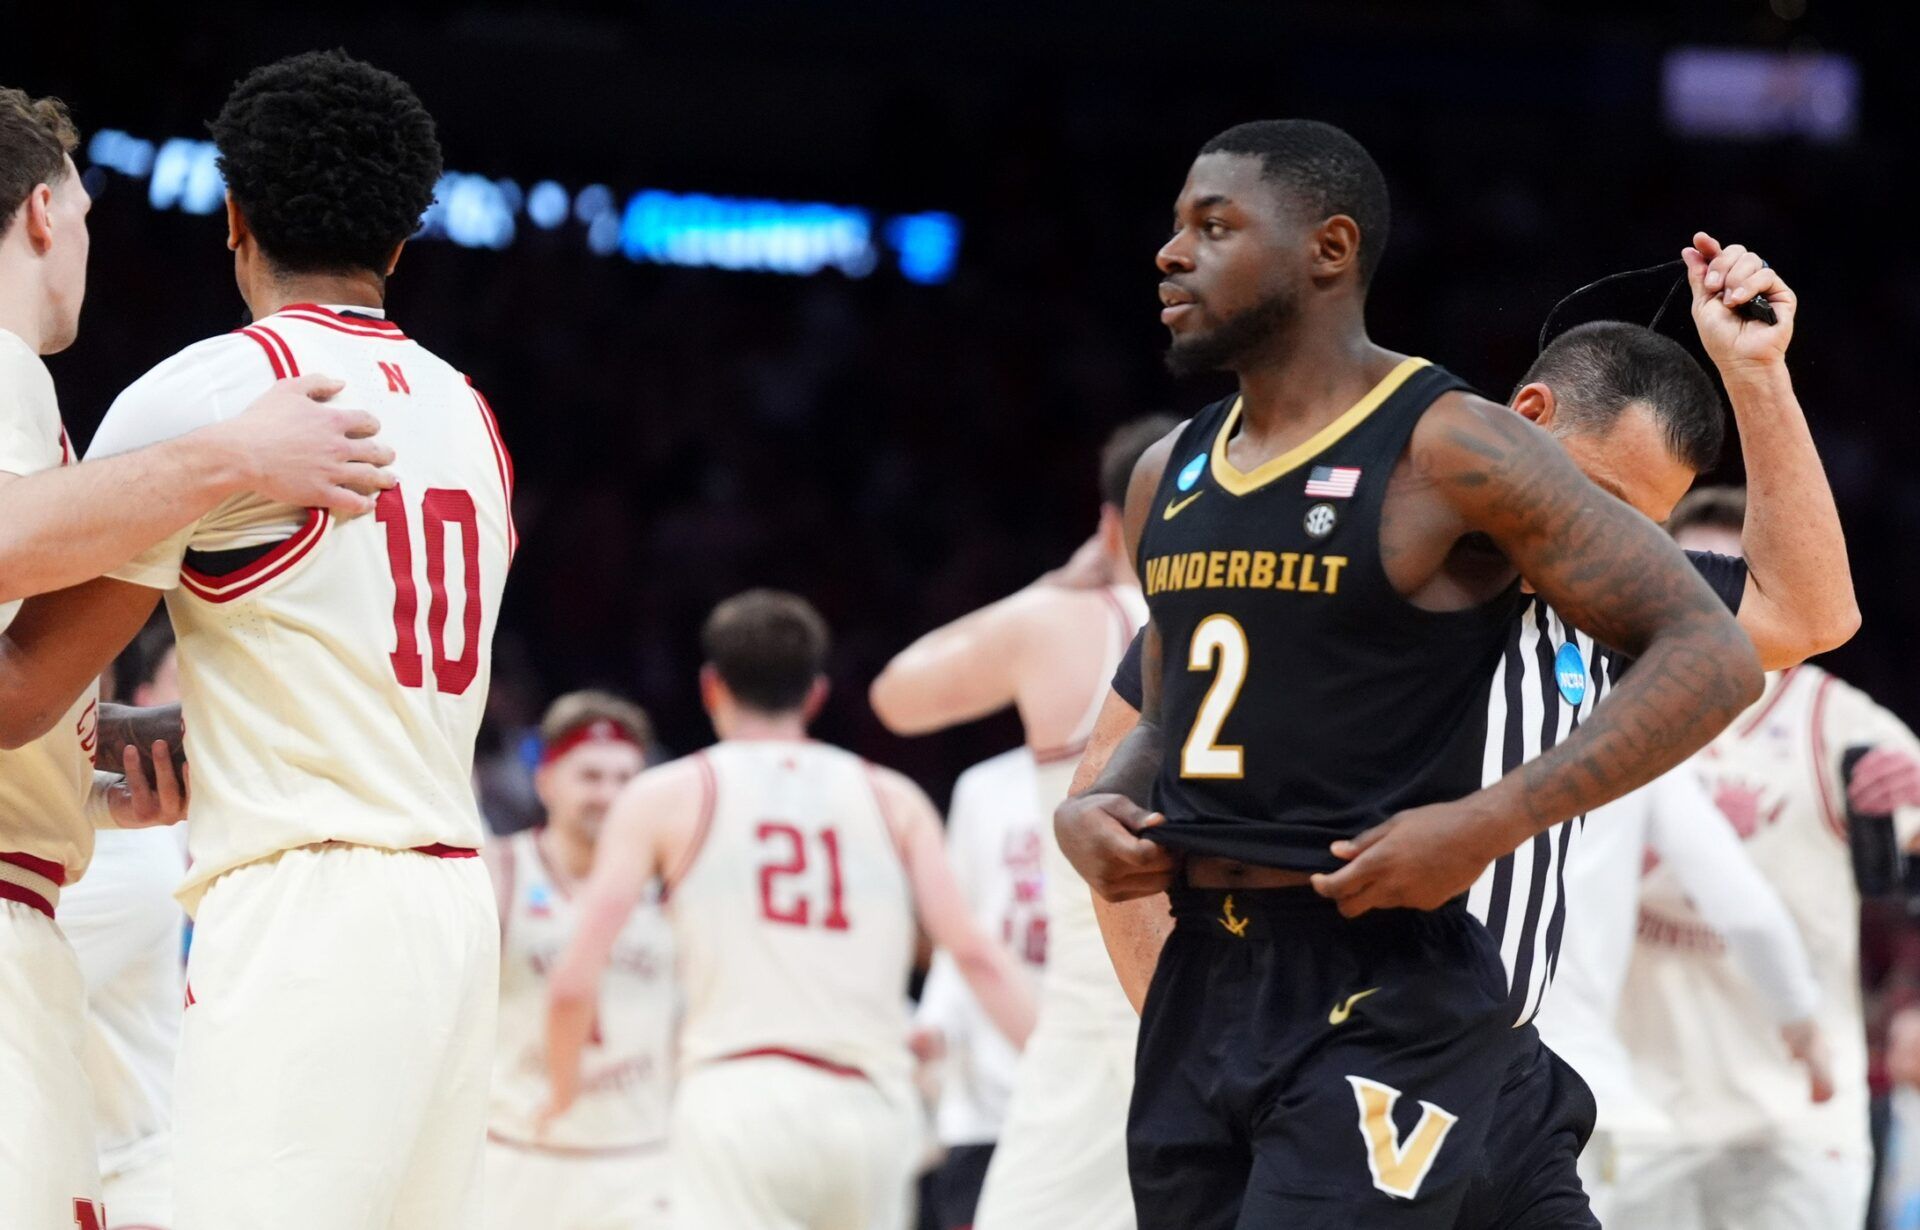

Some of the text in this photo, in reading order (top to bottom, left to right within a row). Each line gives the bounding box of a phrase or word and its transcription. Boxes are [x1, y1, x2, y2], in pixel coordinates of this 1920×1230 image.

[377, 361, 411, 395] N
[375, 482, 481, 695] 10
[1145, 550, 1348, 596] VANDERBILT
[1180, 613, 1249, 778] 2
[1559, 671, 1585, 689] NCAA
[755, 821, 850, 931] 21
[1345, 1074, 1459, 1200] V
